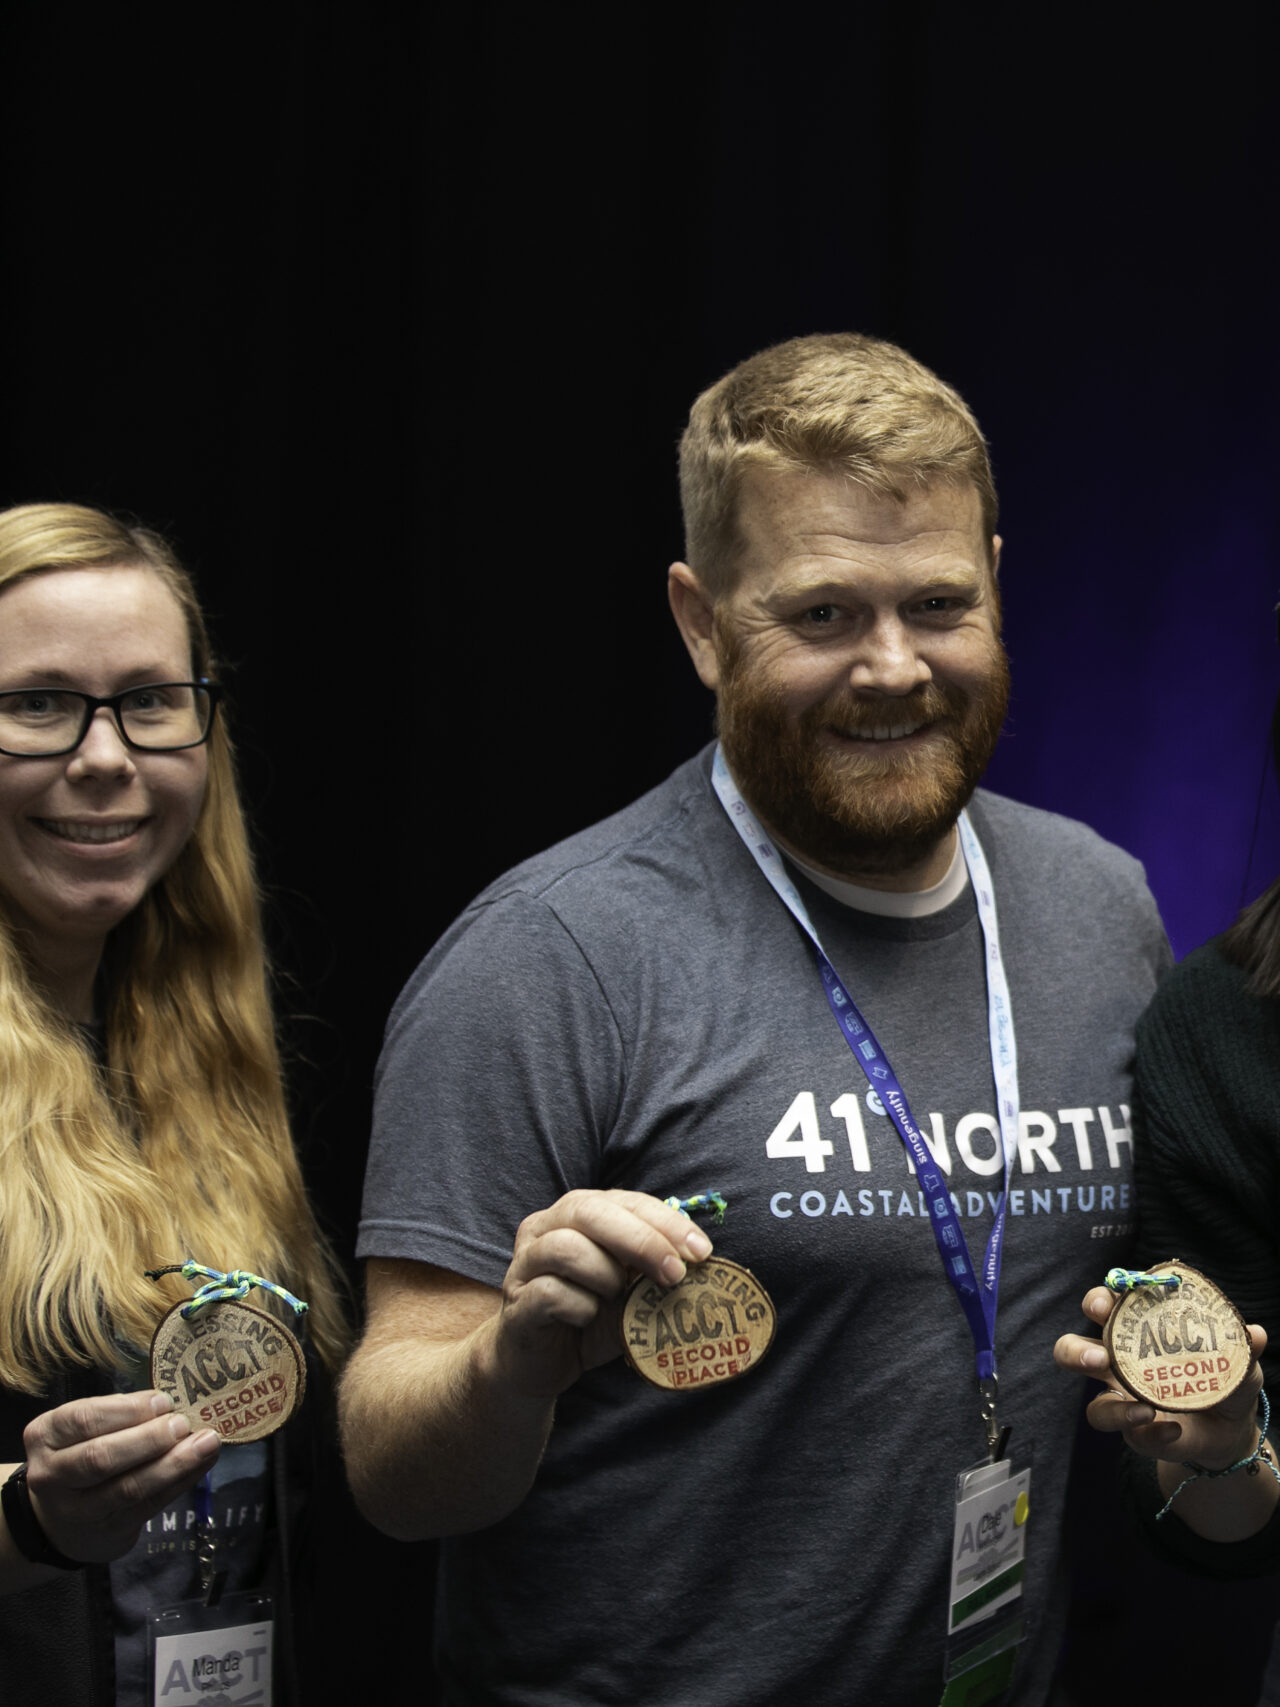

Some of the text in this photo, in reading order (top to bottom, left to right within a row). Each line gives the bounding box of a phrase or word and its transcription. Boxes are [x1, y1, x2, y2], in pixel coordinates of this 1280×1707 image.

[769, 1189, 930, 1219] COASTAL
[656, 1291, 744, 1353] ACCT
[1139, 1310, 1218, 1359] ACCT
[657, 1336, 750, 1369] SECOND
[181, 1338, 262, 1406] ACCT
[675, 1360, 739, 1385] PLACE
[1144, 1357, 1230, 1382] SECOND
[200, 1373, 285, 1421] SECOND
[1160, 1378, 1219, 1400] PLACE
[221, 1398, 283, 1434] PLACE
[193, 1655, 240, 1677] Manda
